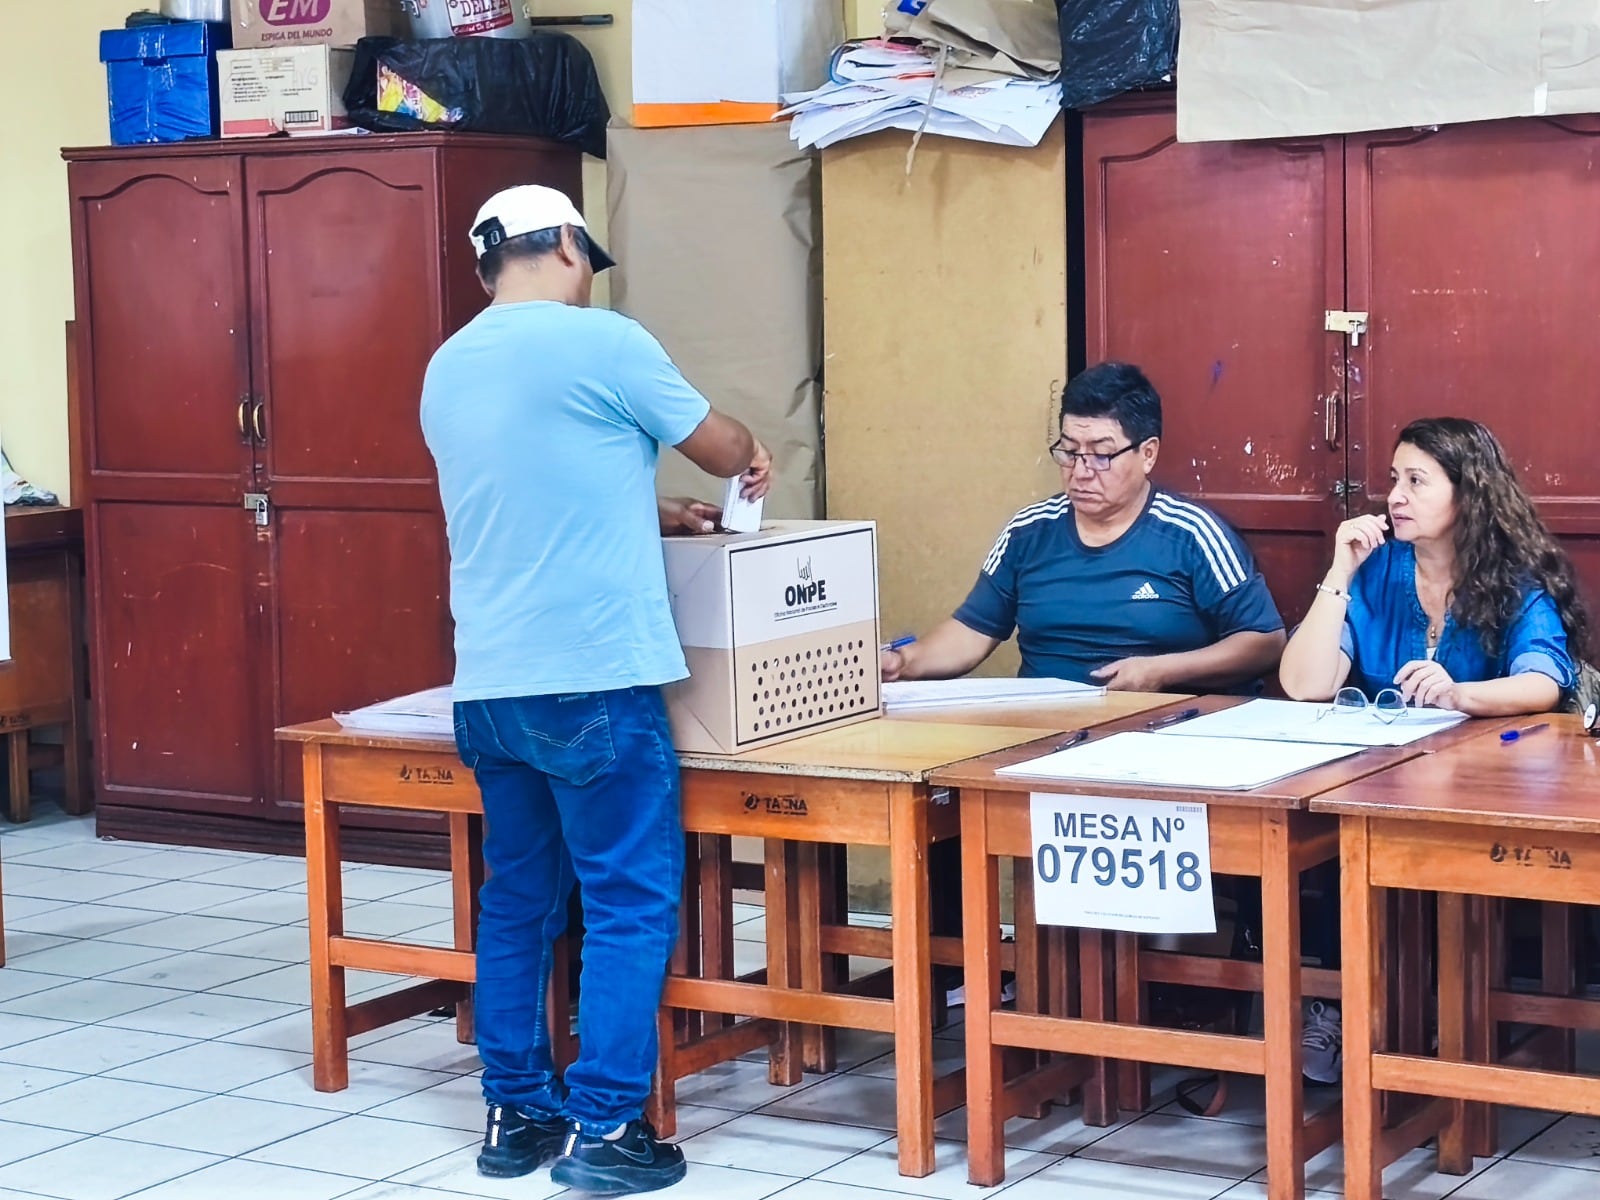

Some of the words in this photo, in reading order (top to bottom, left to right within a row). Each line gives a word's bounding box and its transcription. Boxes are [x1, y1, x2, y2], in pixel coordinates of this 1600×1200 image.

[261, 32, 286, 41] ESPIGA
[287, 31, 301, 40] DEL
[302, 28, 333, 38] MUNDO
[785, 579, 827, 607] ONPE
[1054, 812, 1142, 842] MESA
[1037, 843, 1202, 892] 079518
